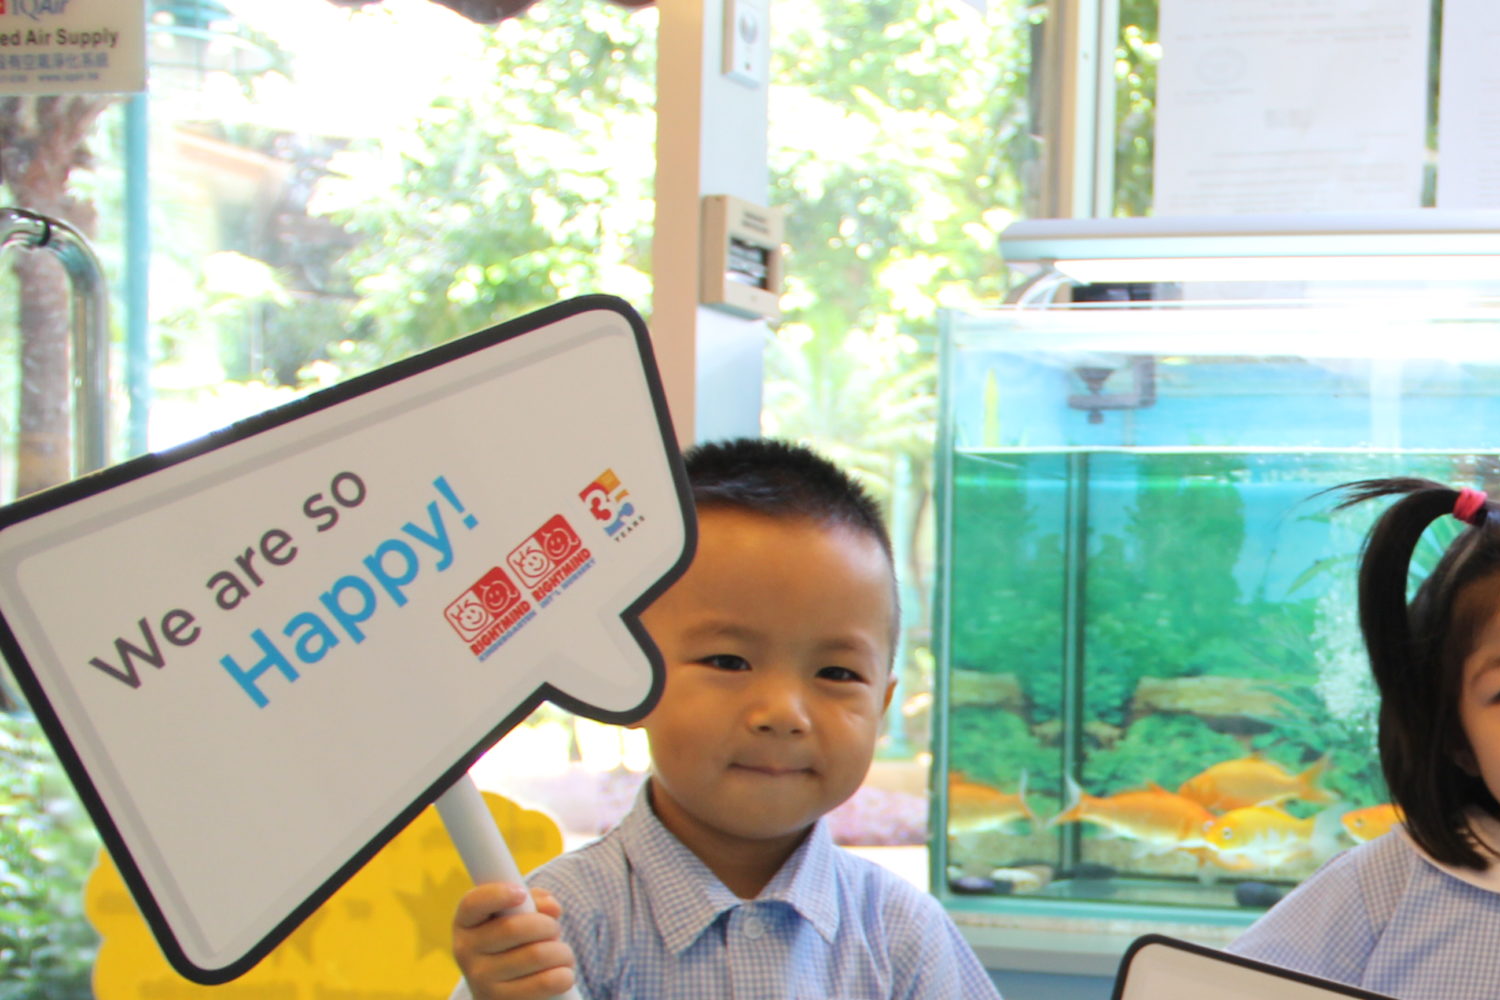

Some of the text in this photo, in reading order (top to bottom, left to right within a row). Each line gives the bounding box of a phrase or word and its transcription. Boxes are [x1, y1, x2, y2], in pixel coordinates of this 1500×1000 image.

[26, 29, 51, 46] Air
[56, 28, 118, 48] Supply
[89, 470, 367, 690] We are so
[219, 475, 479, 709] Happy!
[531, 547, 592, 602] RIGHTMIND
[470, 600, 532, 656] RIGHTMIND
